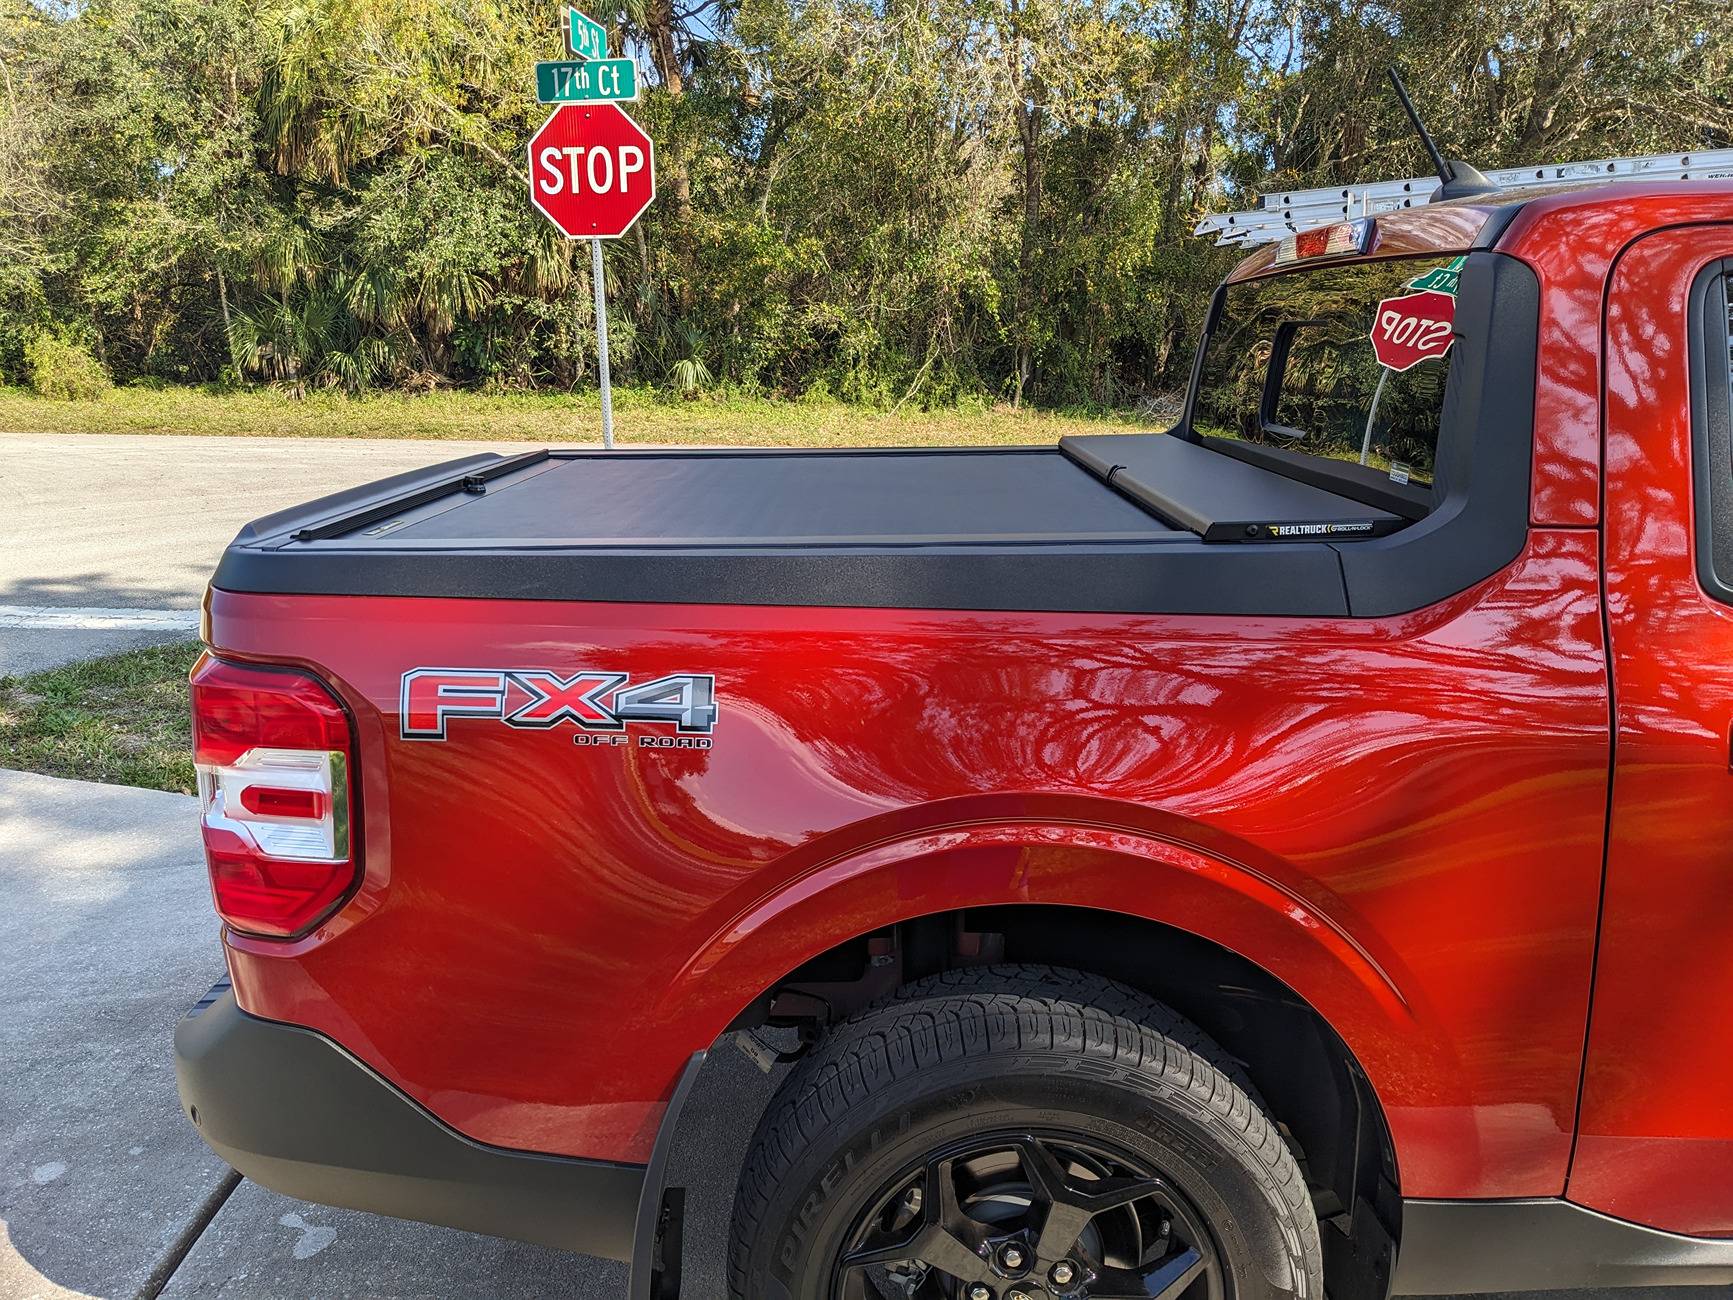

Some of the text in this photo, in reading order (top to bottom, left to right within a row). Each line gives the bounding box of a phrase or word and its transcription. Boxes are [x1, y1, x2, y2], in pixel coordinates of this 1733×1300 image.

[551, 65, 621, 97] 17th Ct
[539, 145, 644, 195] STOP
[1279, 524, 1327, 536] REALTRUCK
[400, 667, 719, 741] FX4
[573, 733, 713, 750] OFF ROAD
[780, 1111, 912, 1273] PIRELLI
